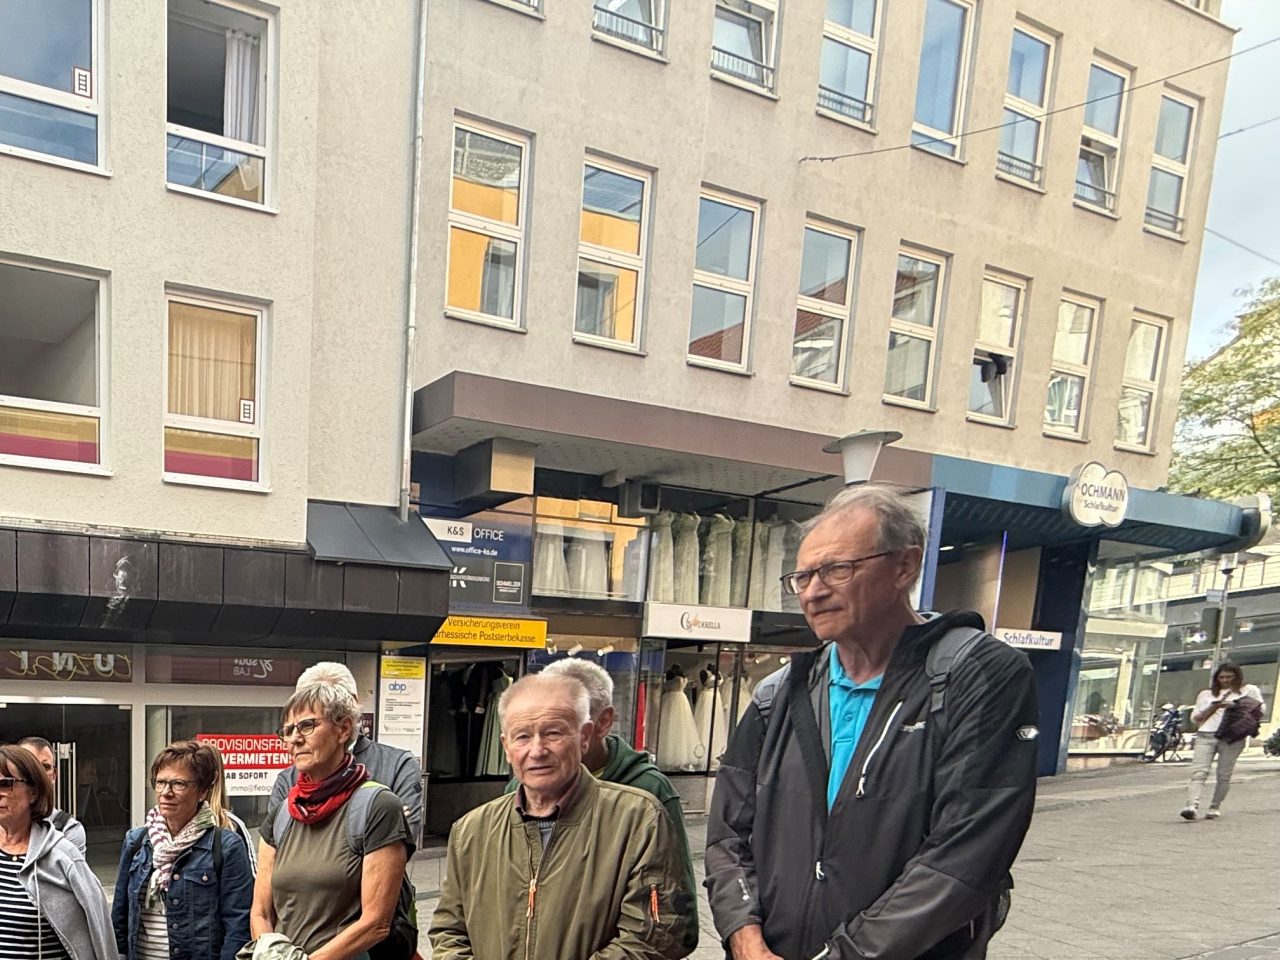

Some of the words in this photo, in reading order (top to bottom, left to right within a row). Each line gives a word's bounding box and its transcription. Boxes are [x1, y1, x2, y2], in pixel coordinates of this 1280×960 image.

[1081, 484, 1125, 502] OCHMANN
[447, 526, 464, 536] K&S
[474, 528, 504, 541] OFFICE
[451, 546, 498, 556] www.office-ks.de
[448, 617, 520, 631] Versicherungsverein
[479, 631, 536, 643] Poststerbekasse
[1004, 632, 1054, 647] Schlafkultur
[388, 681, 407, 693] abp
[226, 772, 236, 780] AB
[239, 772, 268, 780] SOFORT
